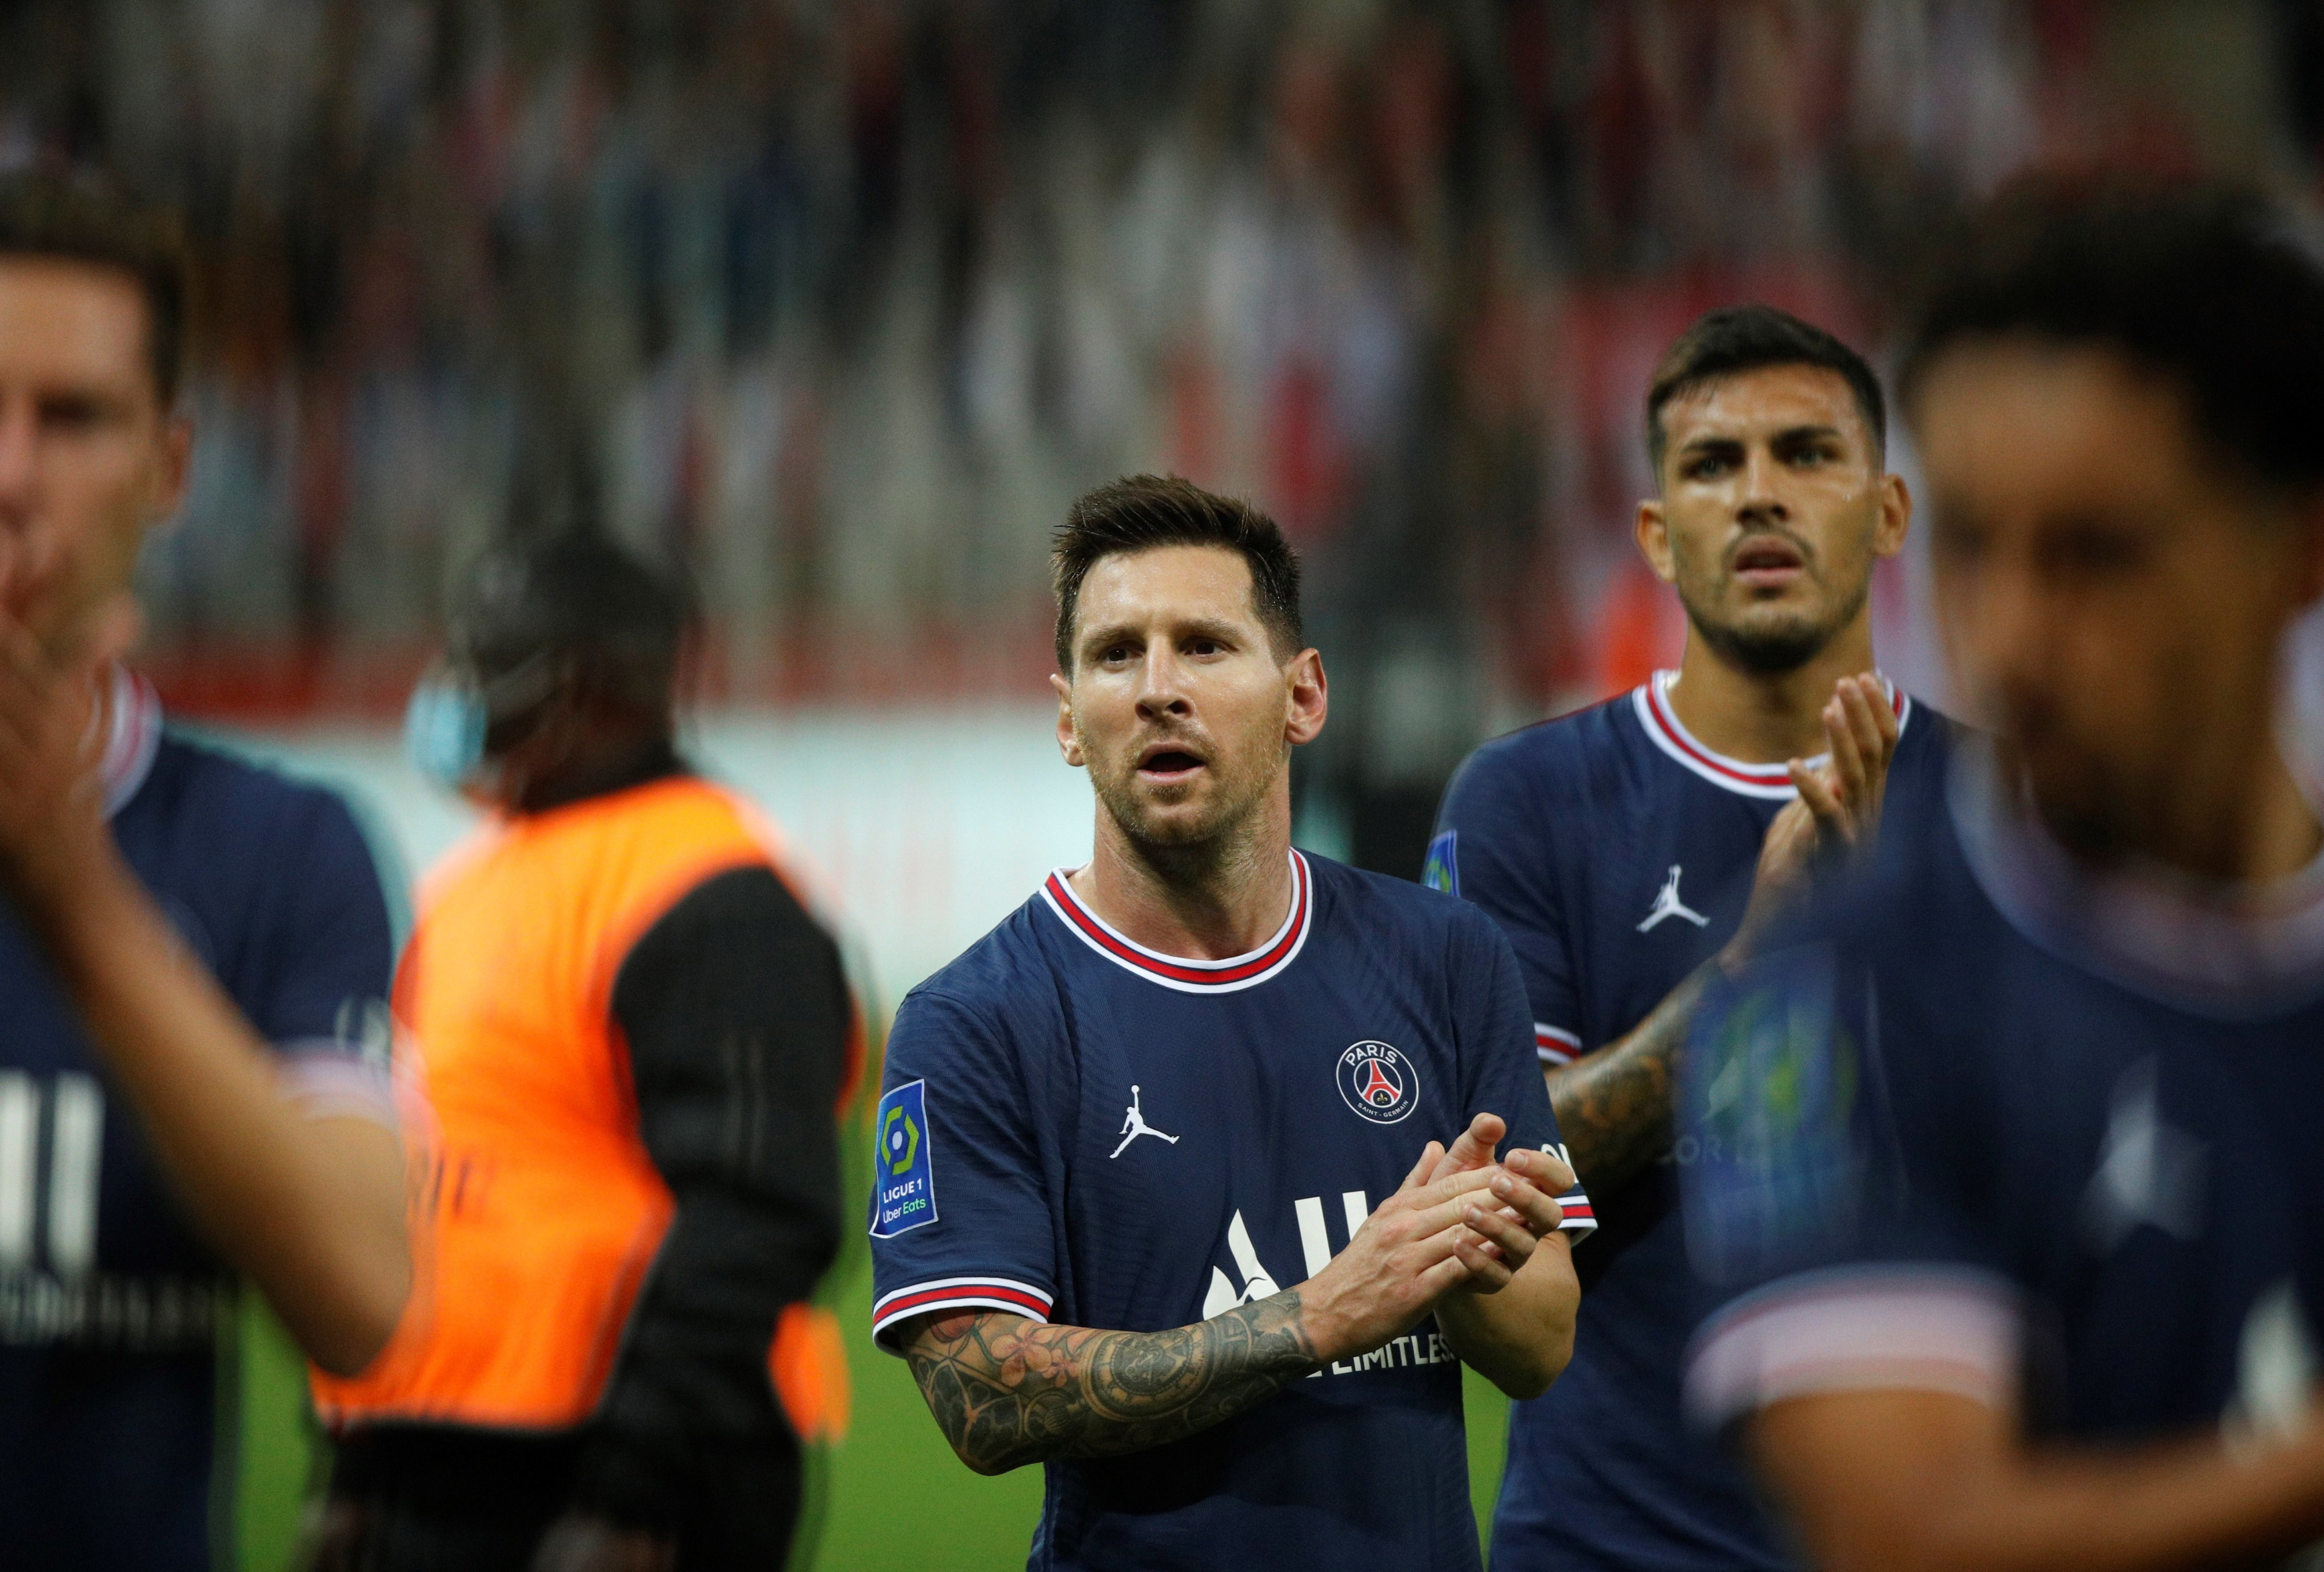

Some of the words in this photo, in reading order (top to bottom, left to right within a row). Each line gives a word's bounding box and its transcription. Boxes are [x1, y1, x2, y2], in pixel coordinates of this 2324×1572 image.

[1344, 1044, 1397, 1066] PARIS
[1357, 1102, 1378, 1116] SAINT
[1383, 1100, 1409, 1117] GERMAIN
[883, 1180, 915, 1204] LIGUE
[916, 1177, 923, 1190] 1
[883, 1206, 902, 1224] Uber
[902, 1198, 927, 1215] Eats
